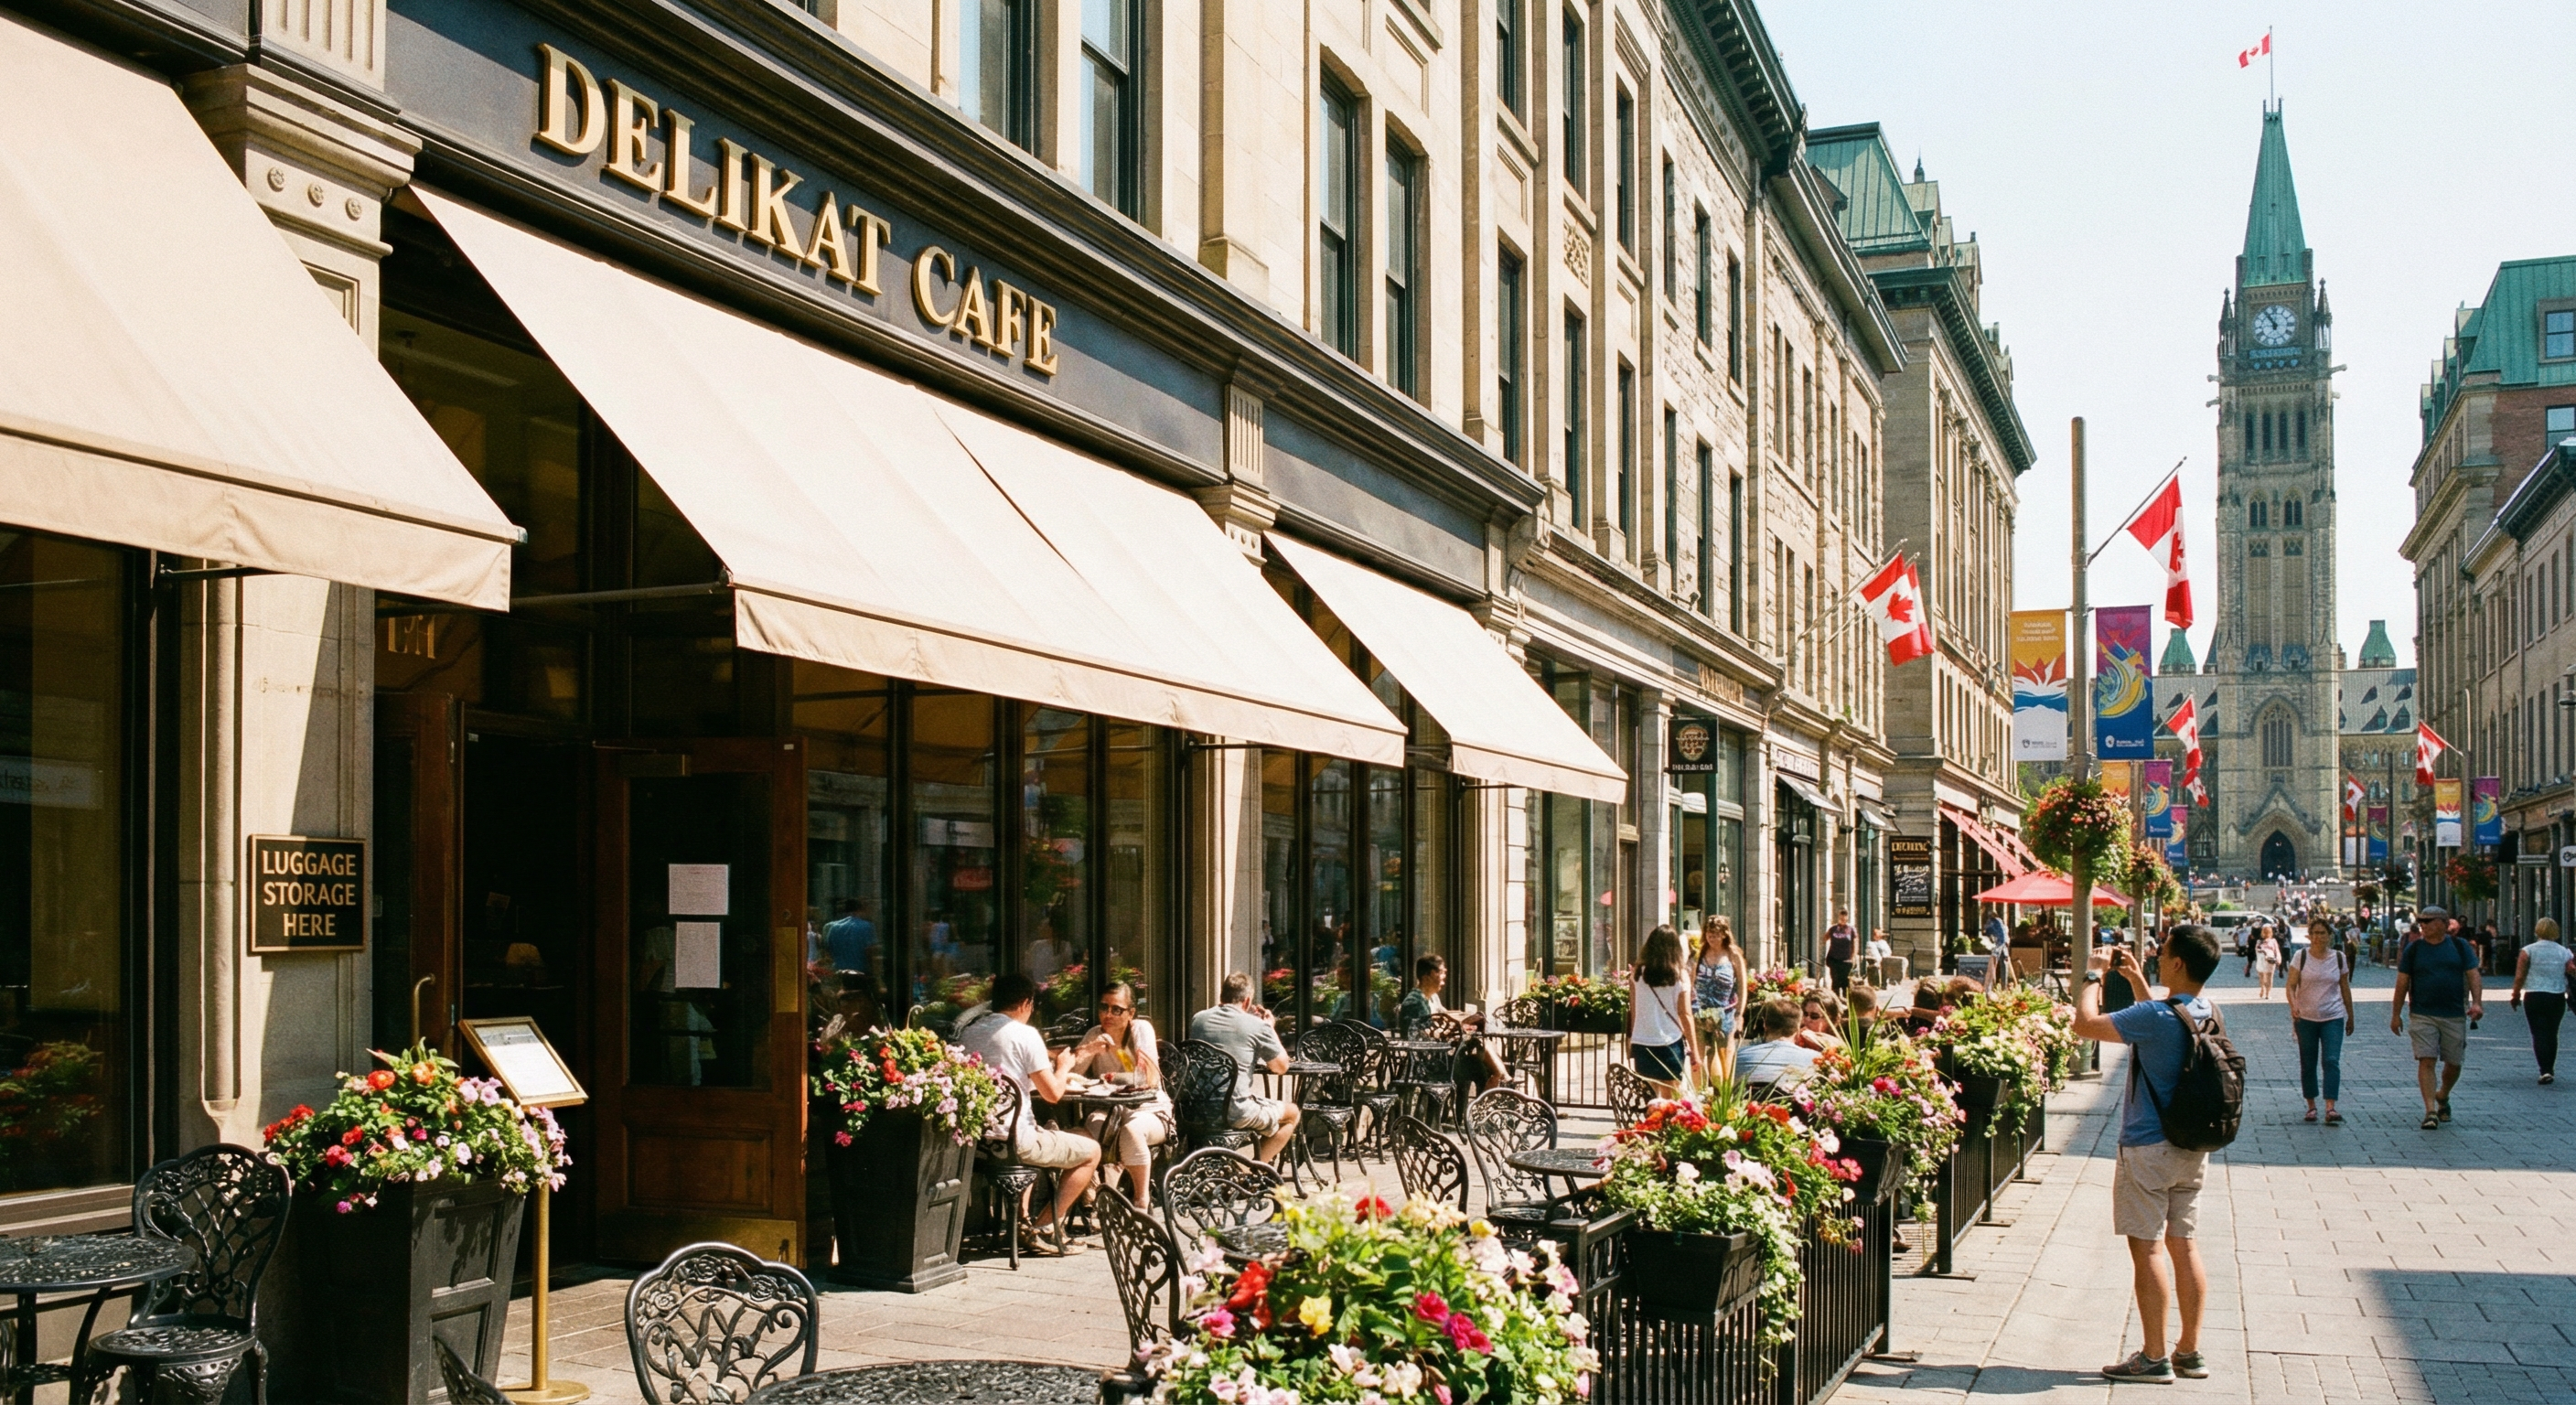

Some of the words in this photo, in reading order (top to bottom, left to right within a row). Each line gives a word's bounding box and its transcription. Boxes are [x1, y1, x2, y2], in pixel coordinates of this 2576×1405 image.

[534, 43, 892, 296] DELIKAT
[911, 245, 1057, 377] CAFE
[263, 850, 357, 876] LUGGAGE
[263, 881, 357, 906] STORAGE
[284, 913, 336, 937] HERE
